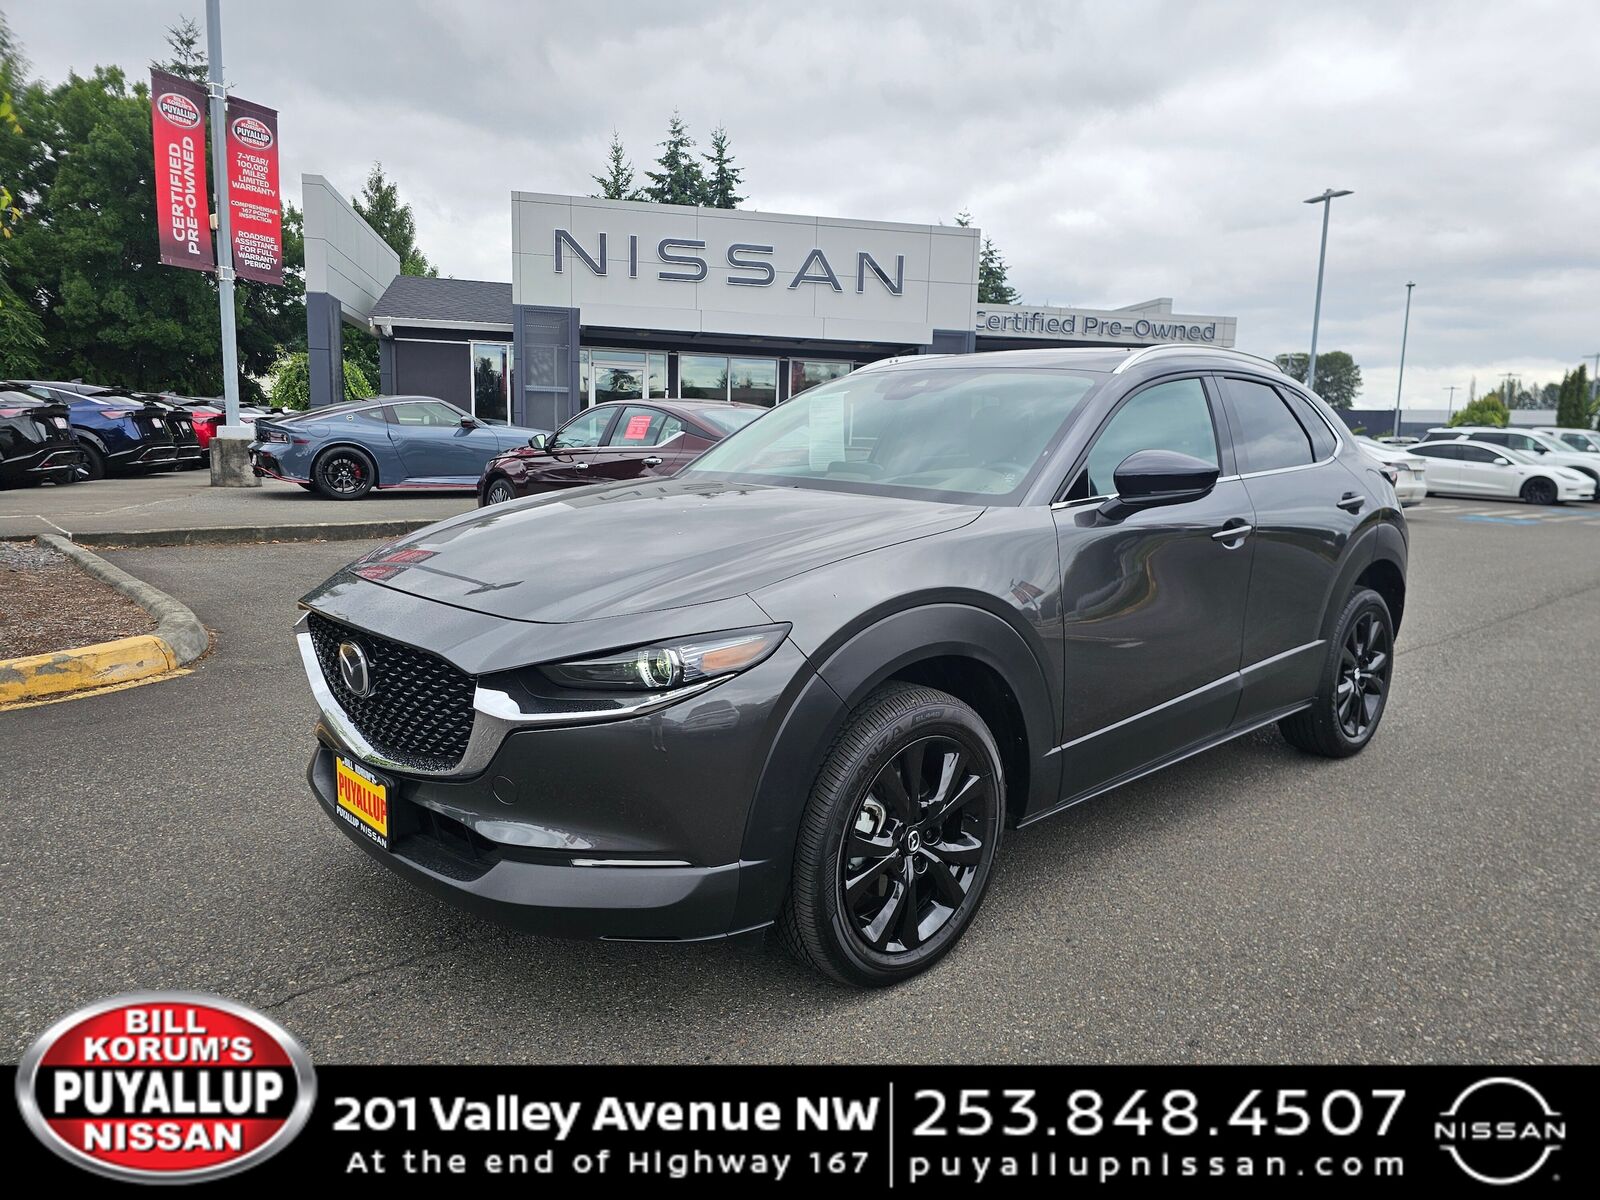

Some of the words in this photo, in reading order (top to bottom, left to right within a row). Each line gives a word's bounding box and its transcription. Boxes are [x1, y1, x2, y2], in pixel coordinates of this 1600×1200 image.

[162, 103, 197, 121] PUYALLUP
[236, 126, 270, 143] PUYALLUP
[236, 159, 269, 174] 100,000
[237, 152, 269, 167] 7-YEAR/
[238, 174, 270, 188] LIMITED
[242, 168, 266, 180] MILES
[169, 143, 185, 241] CERTIFIED
[183, 136, 200, 255] PRE-OWNED
[231, 180, 276, 197] WARRANTY
[230, 200, 279, 216] COMPREHENSIVE
[252, 209, 270, 218] POINT
[238, 211, 272, 224] INSPECTION
[234, 237, 279, 252] ASSISTANCE
[238, 230, 276, 244] ROADSIDE
[237, 250, 278, 265] WARRANTY
[239, 244, 257, 254] FOR
[256, 247, 274, 258] FULL
[244, 259, 272, 270] PERIOD
[553, 228, 905, 296] NISSAN
[1083, 316, 1217, 342] Pre-Owned
[338, 771, 388, 825] PUYALLUP
[360, 823, 388, 849] NISSAN
